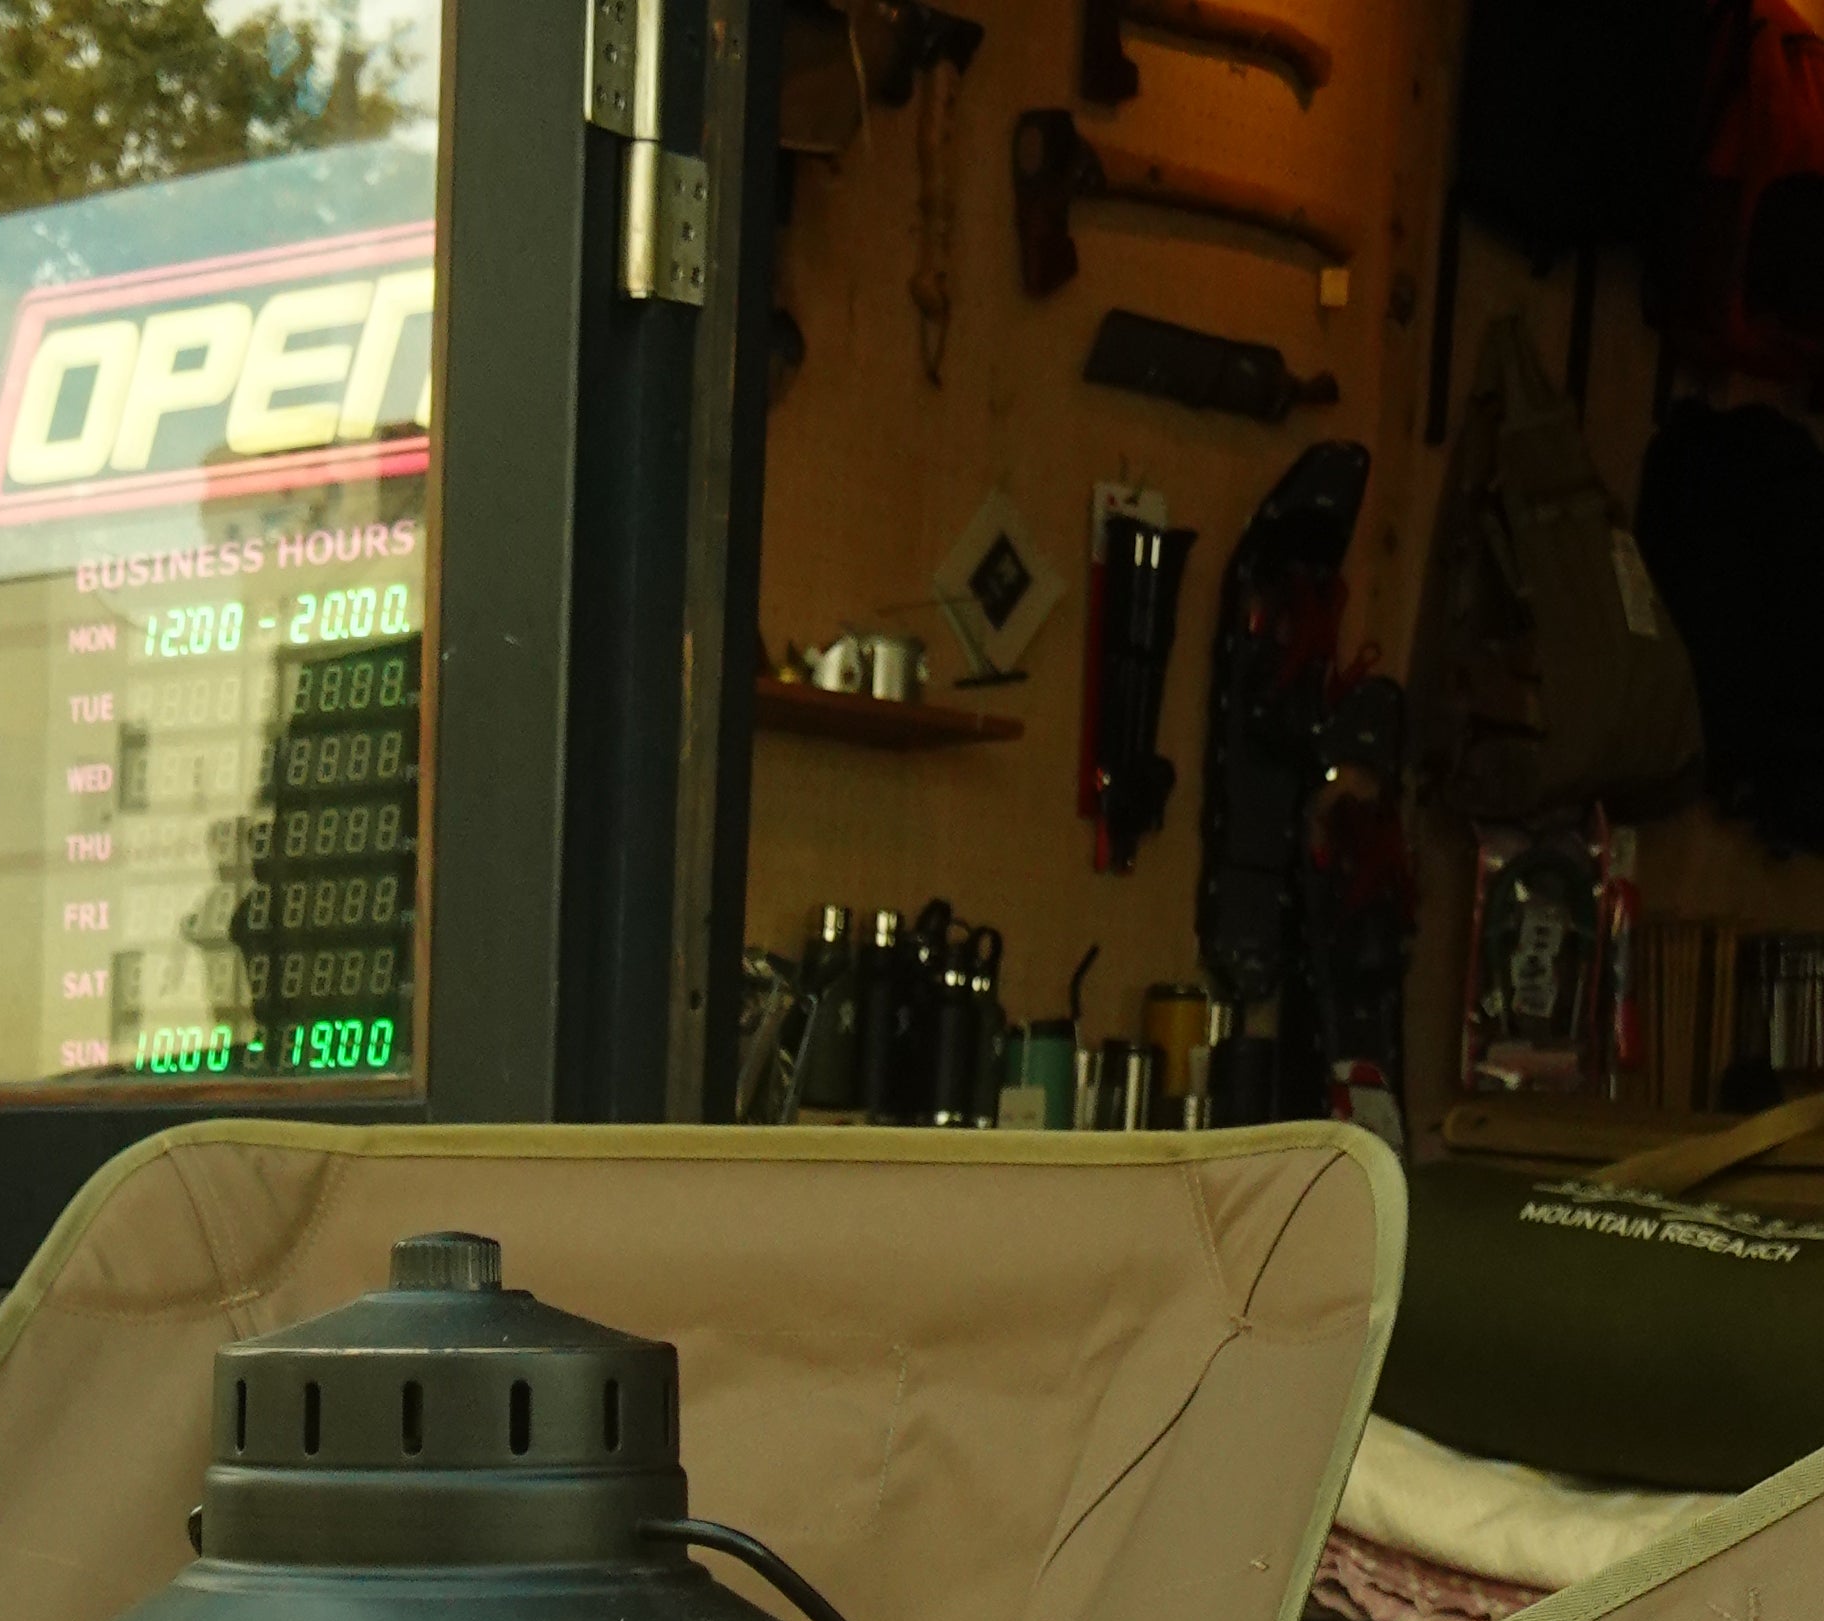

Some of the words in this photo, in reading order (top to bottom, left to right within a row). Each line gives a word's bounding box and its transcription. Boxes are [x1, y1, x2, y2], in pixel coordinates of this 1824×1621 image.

[7, 266, 436, 486] OPEN
[76, 537, 264, 593] BUSINESS
[277, 519, 417, 571] HOURS
[68, 624, 117, 653] MON
[69, 694, 114, 723] TUE
[66, 763, 113, 793] WED
[65, 833, 112, 862] THU
[64, 902, 109, 931] FRI
[62, 970, 108, 1000] SAT
[61, 1040, 109, 1068] SUN
[1520, 1200, 1661, 1241] MOUNTAIN
[1658, 1220, 1802, 1263] RESEARCH
